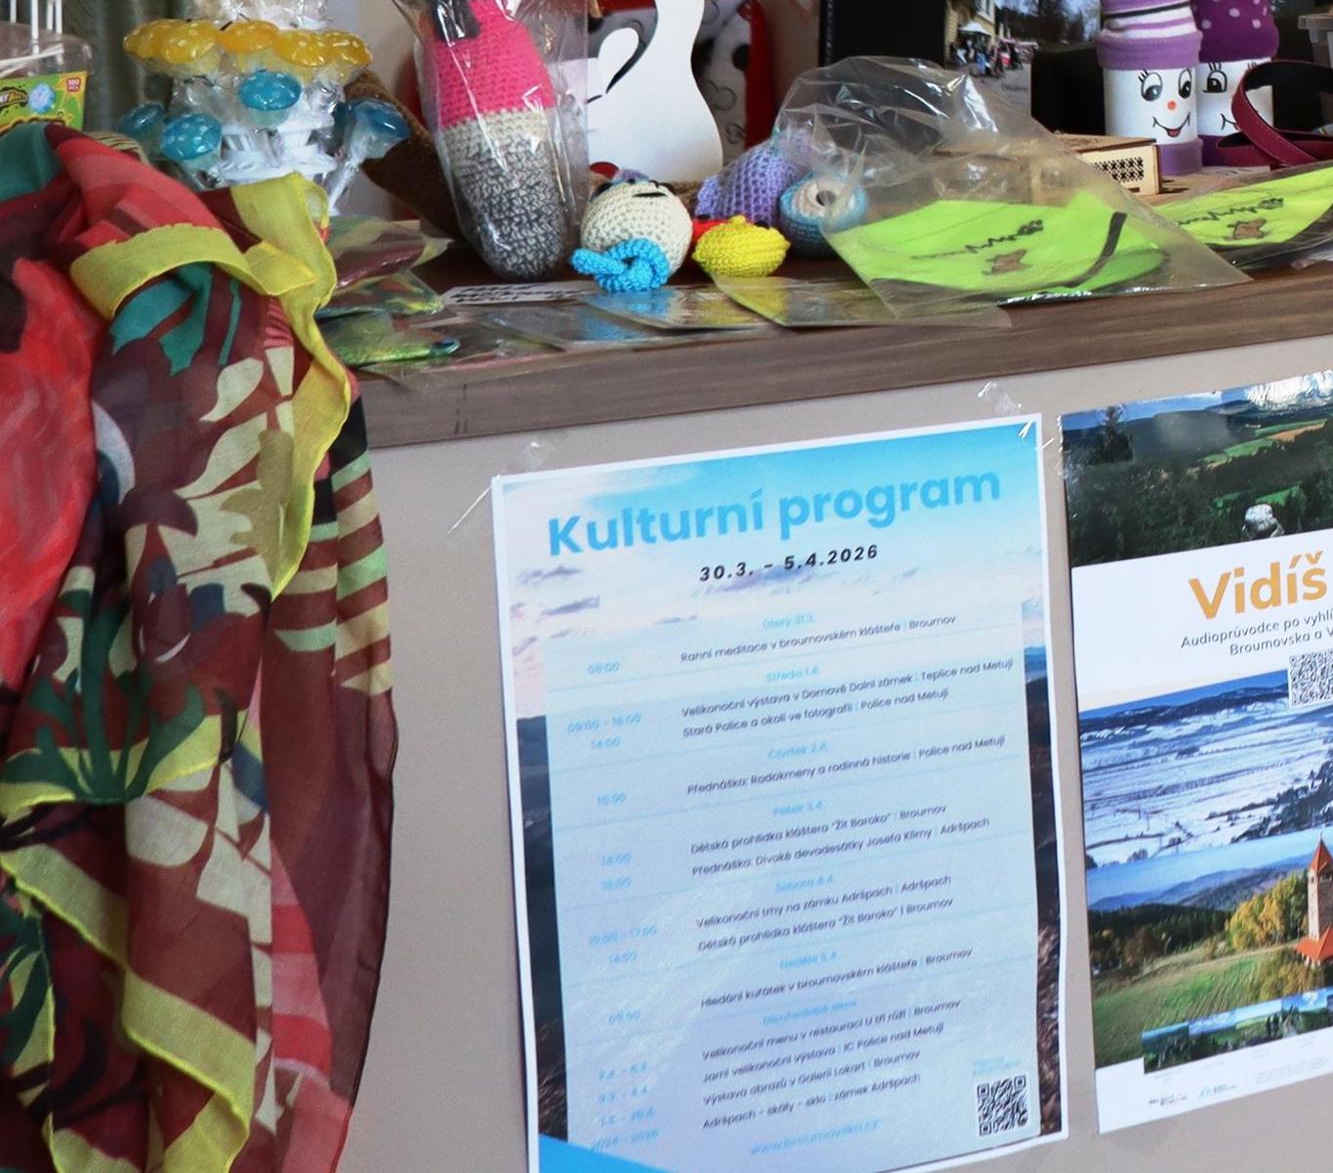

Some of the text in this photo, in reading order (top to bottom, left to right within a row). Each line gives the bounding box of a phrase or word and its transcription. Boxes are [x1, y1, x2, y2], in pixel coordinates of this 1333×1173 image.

[545, 467, 1002, 559] Kulturní program
[697, 542, 881, 584] 30.3. 5.4.2026
[1187, 549, 1328, 620] Vidíš
[1179, 620, 1279, 649] Audioprůvodce
[1282, 617, 1300, 632] po
[1228, 631, 1311, 656] Broumovska
[1312, 629, 1323, 640] a
